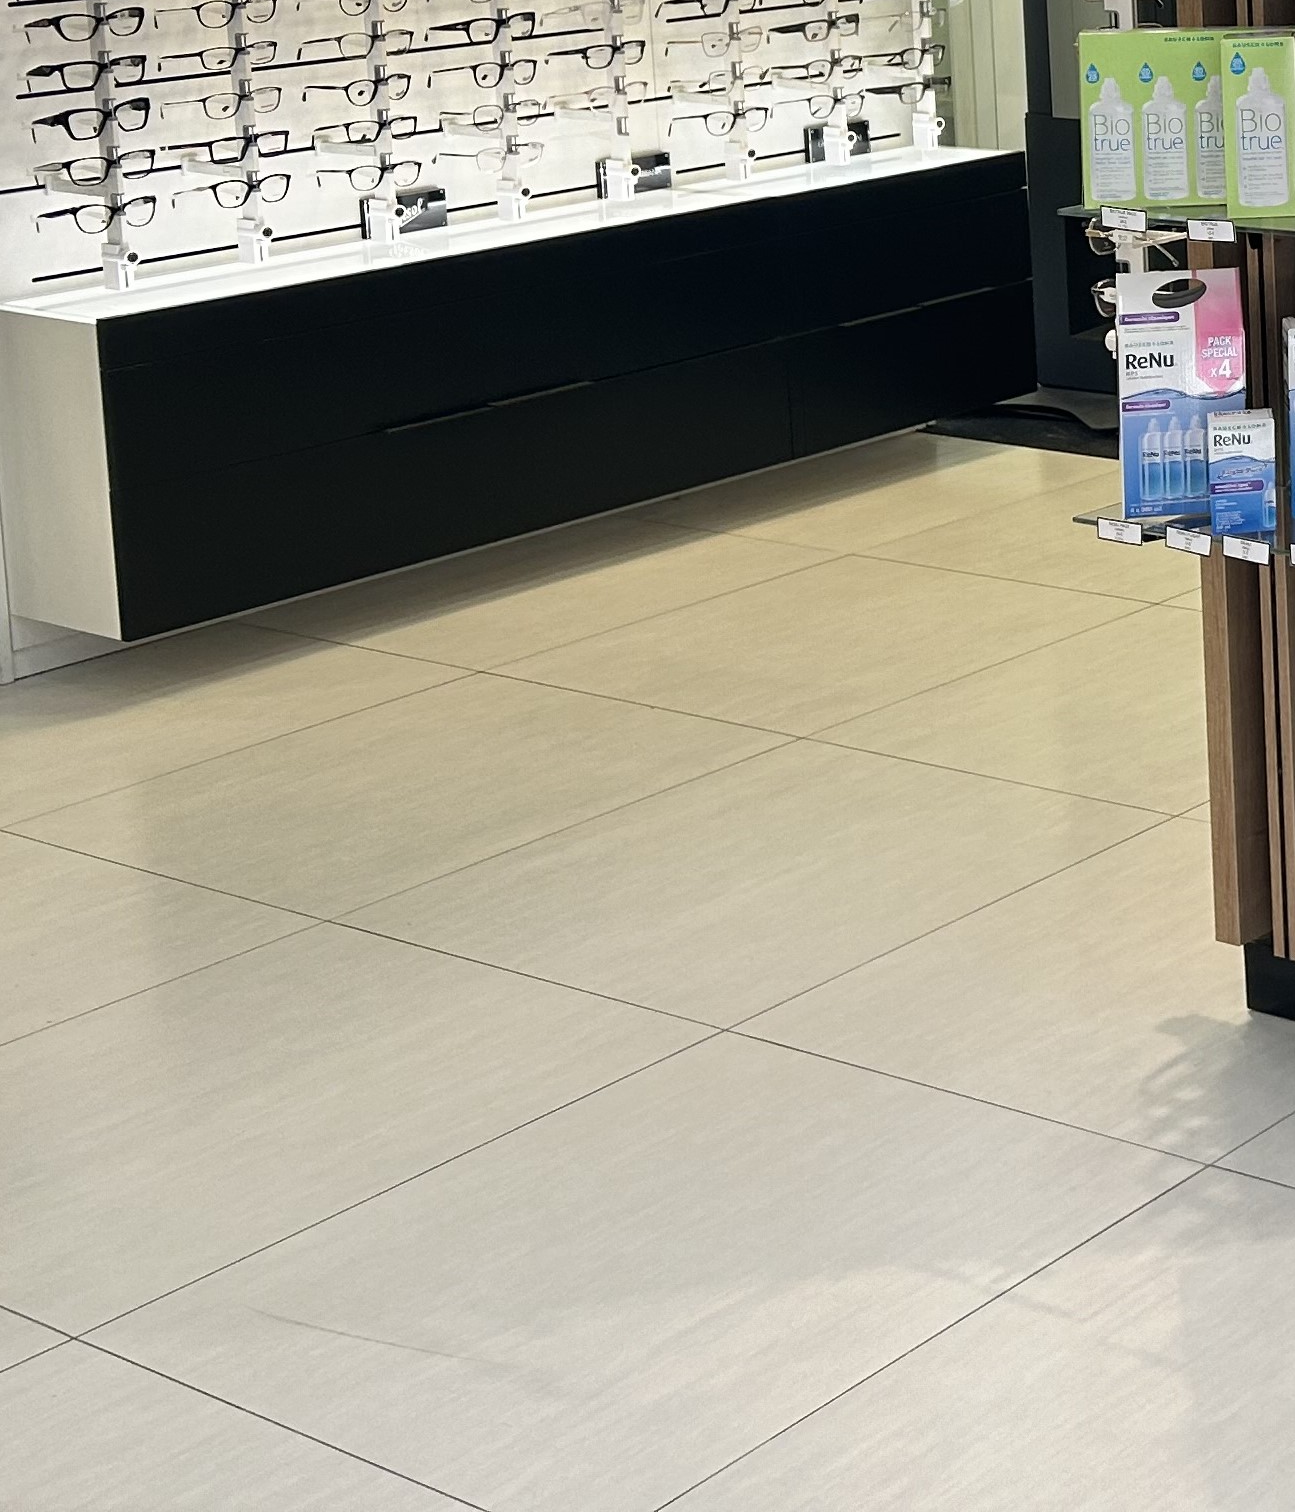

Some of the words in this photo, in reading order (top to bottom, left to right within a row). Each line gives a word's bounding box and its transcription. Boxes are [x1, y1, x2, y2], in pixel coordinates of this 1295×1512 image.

[1094, 114, 1130, 135] Bio
[1146, 113, 1183, 135] Bio
[1199, 111, 1225, 134] Bi
[1240, 109, 1282, 133] Bio
[1094, 135, 1131, 152] true
[1146, 134, 1184, 151] true
[1199, 133, 1225, 149] tru
[1241, 133, 1283, 151] true
[1208, 336, 1232, 347] PACK
[1125, 352, 1175, 370] ReNu
[1201, 347, 1238, 358] SPECIAL
[1213, 433, 1251, 447] ReNu
